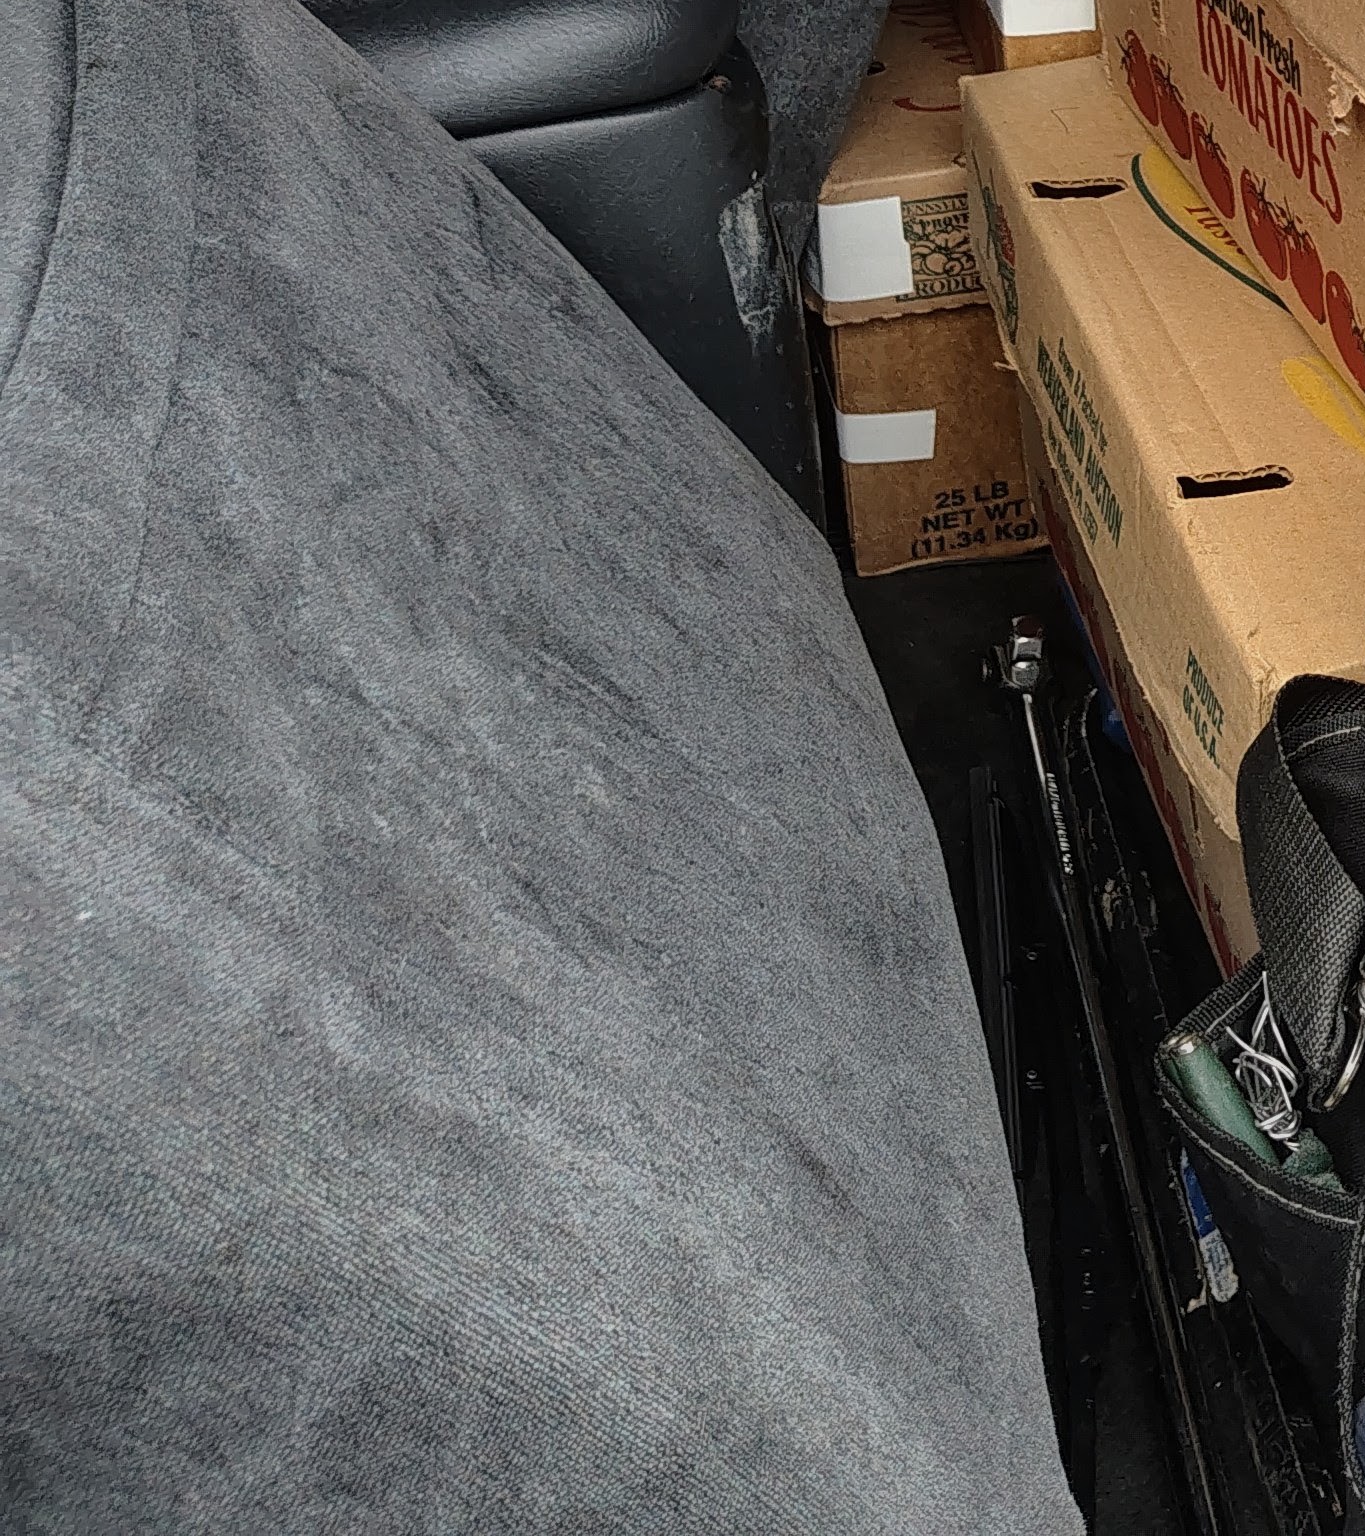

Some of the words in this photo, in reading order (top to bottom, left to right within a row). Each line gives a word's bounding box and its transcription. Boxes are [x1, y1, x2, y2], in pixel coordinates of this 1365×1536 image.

[1257, 3, 1302, 97] Fresh
[921, 508, 975, 534] NET
[984, 498, 1026, 521] WT
[934, 487, 966, 510] 25
[973, 480, 1009, 502] LB
[911, 527, 986, 559] (11.34
[994, 517, 1039, 541] Kg)
[1186, 646, 1224, 737] PRODUCE
